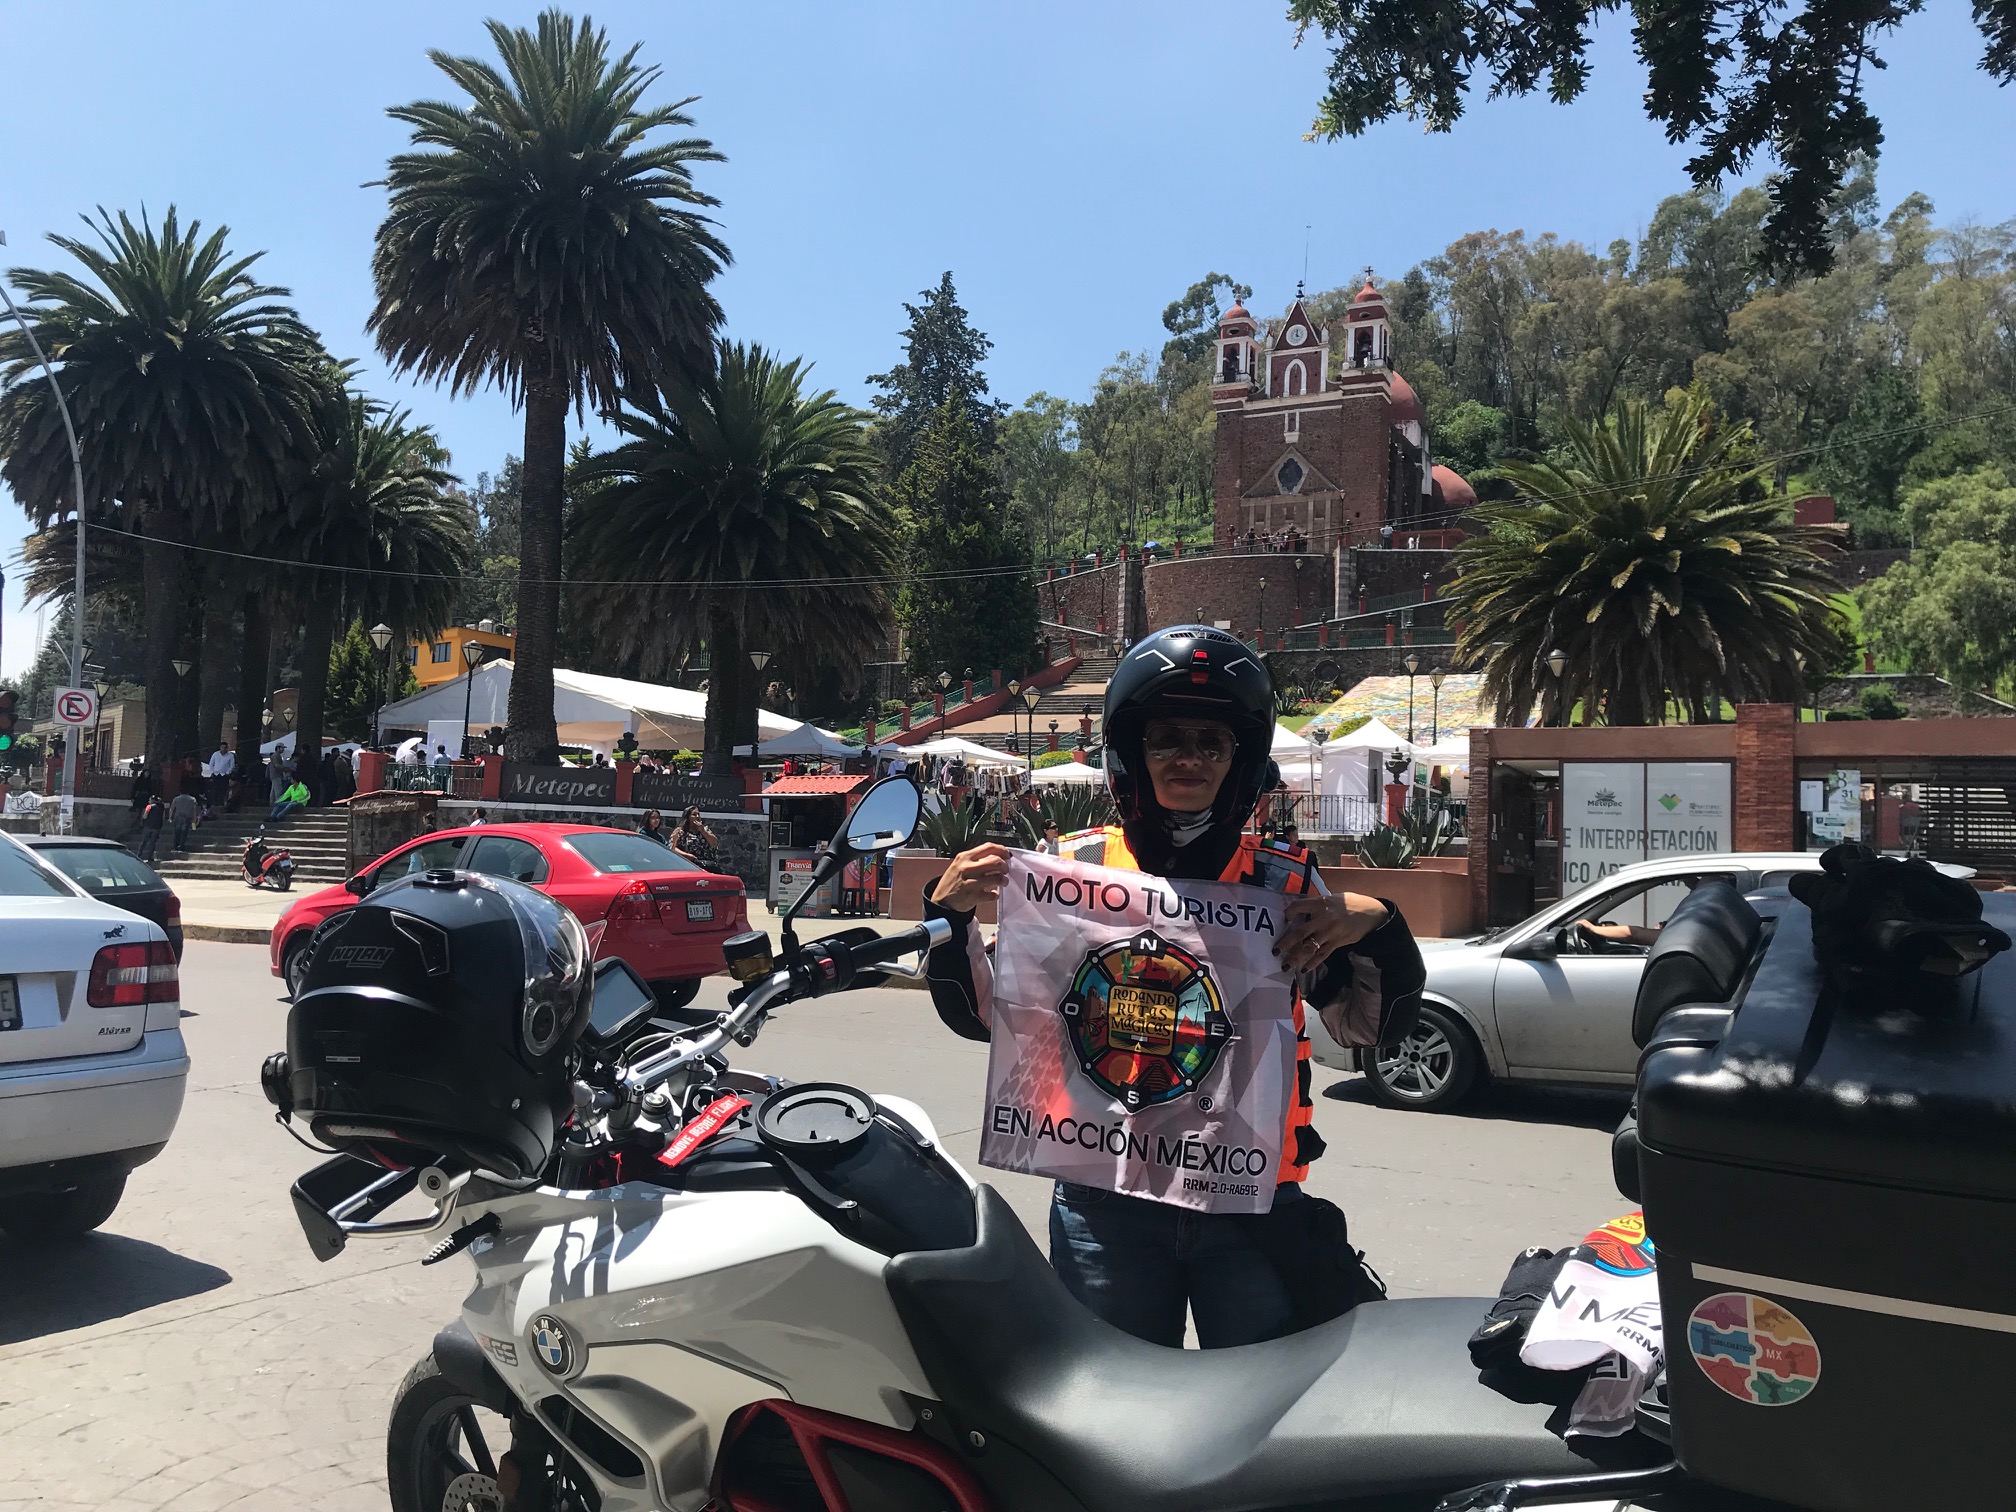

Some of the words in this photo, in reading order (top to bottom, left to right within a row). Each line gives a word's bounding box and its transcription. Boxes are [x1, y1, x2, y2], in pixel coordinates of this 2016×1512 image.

[510, 773, 611, 801] Metepec
[641, 774, 659, 786] En
[663, 775, 674, 787] el
[677, 776, 713, 789] Cerro
[639, 790, 652, 803] de
[657, 791, 675, 804] los
[1842, 790, 1853, 798] 31
[1587, 800, 1623, 808] Metepec
[1579, 826, 1717, 851] INTERPRETACIÓN
[1026, 872, 1130, 912] MOTO
[1141, 886, 1275, 936] TURISTA
[1140, 937, 1158, 951] N
[328, 946, 395, 968] NOLAN
[1064, 1002, 1080, 1016] O
[1211, 1023, 1225, 1036] E
[1127, 1090, 1140, 1105] S
[662, 1134, 695, 1160] REMOVE
[689, 1116, 717, 1138] BEFORE
[711, 1099, 738, 1118] FLIGHT
[992, 1105, 1031, 1137] EN
[1037, 1114, 1149, 1162] ACCIÓN
[1156, 1133, 1267, 1176] MÉXICO
[1183, 1178, 1209, 1192] RRM
[532, 1319, 564, 1340] BMW
[1766, 1348, 1783, 1361] MX
